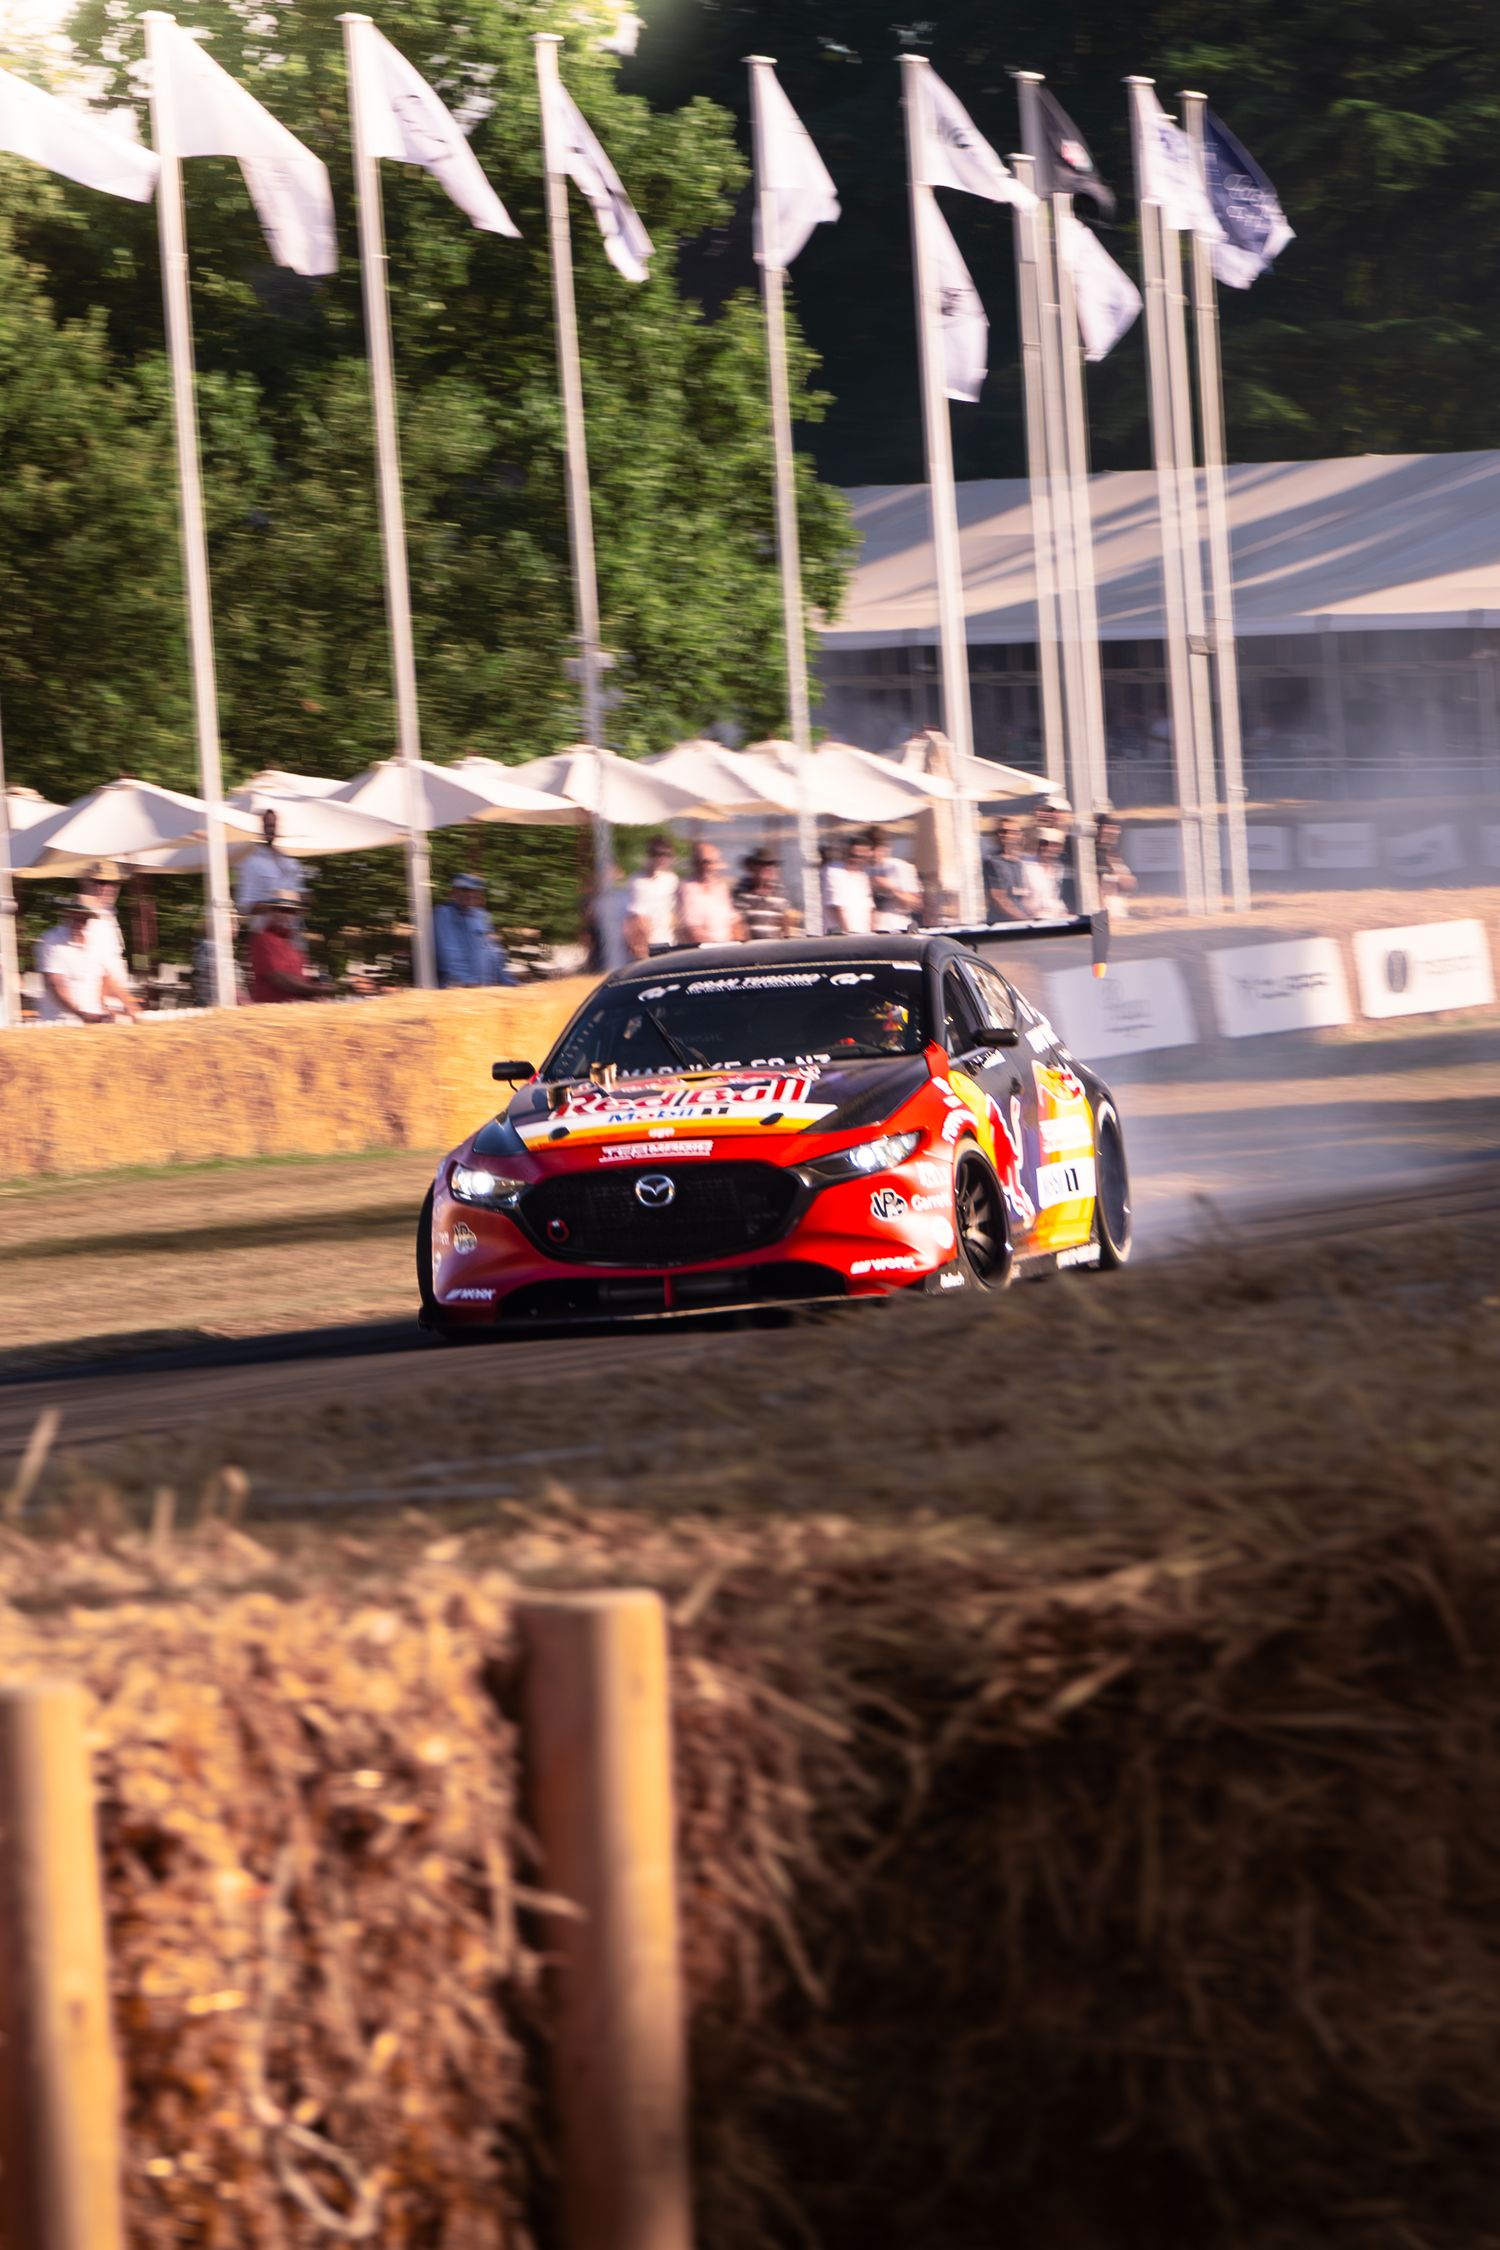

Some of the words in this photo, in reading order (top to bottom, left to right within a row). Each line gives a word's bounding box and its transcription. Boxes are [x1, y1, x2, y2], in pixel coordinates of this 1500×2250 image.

[549, 1090, 681, 1120] Red
[681, 1079, 813, 1107] Bull
[608, 1107, 694, 1123] Mobil
